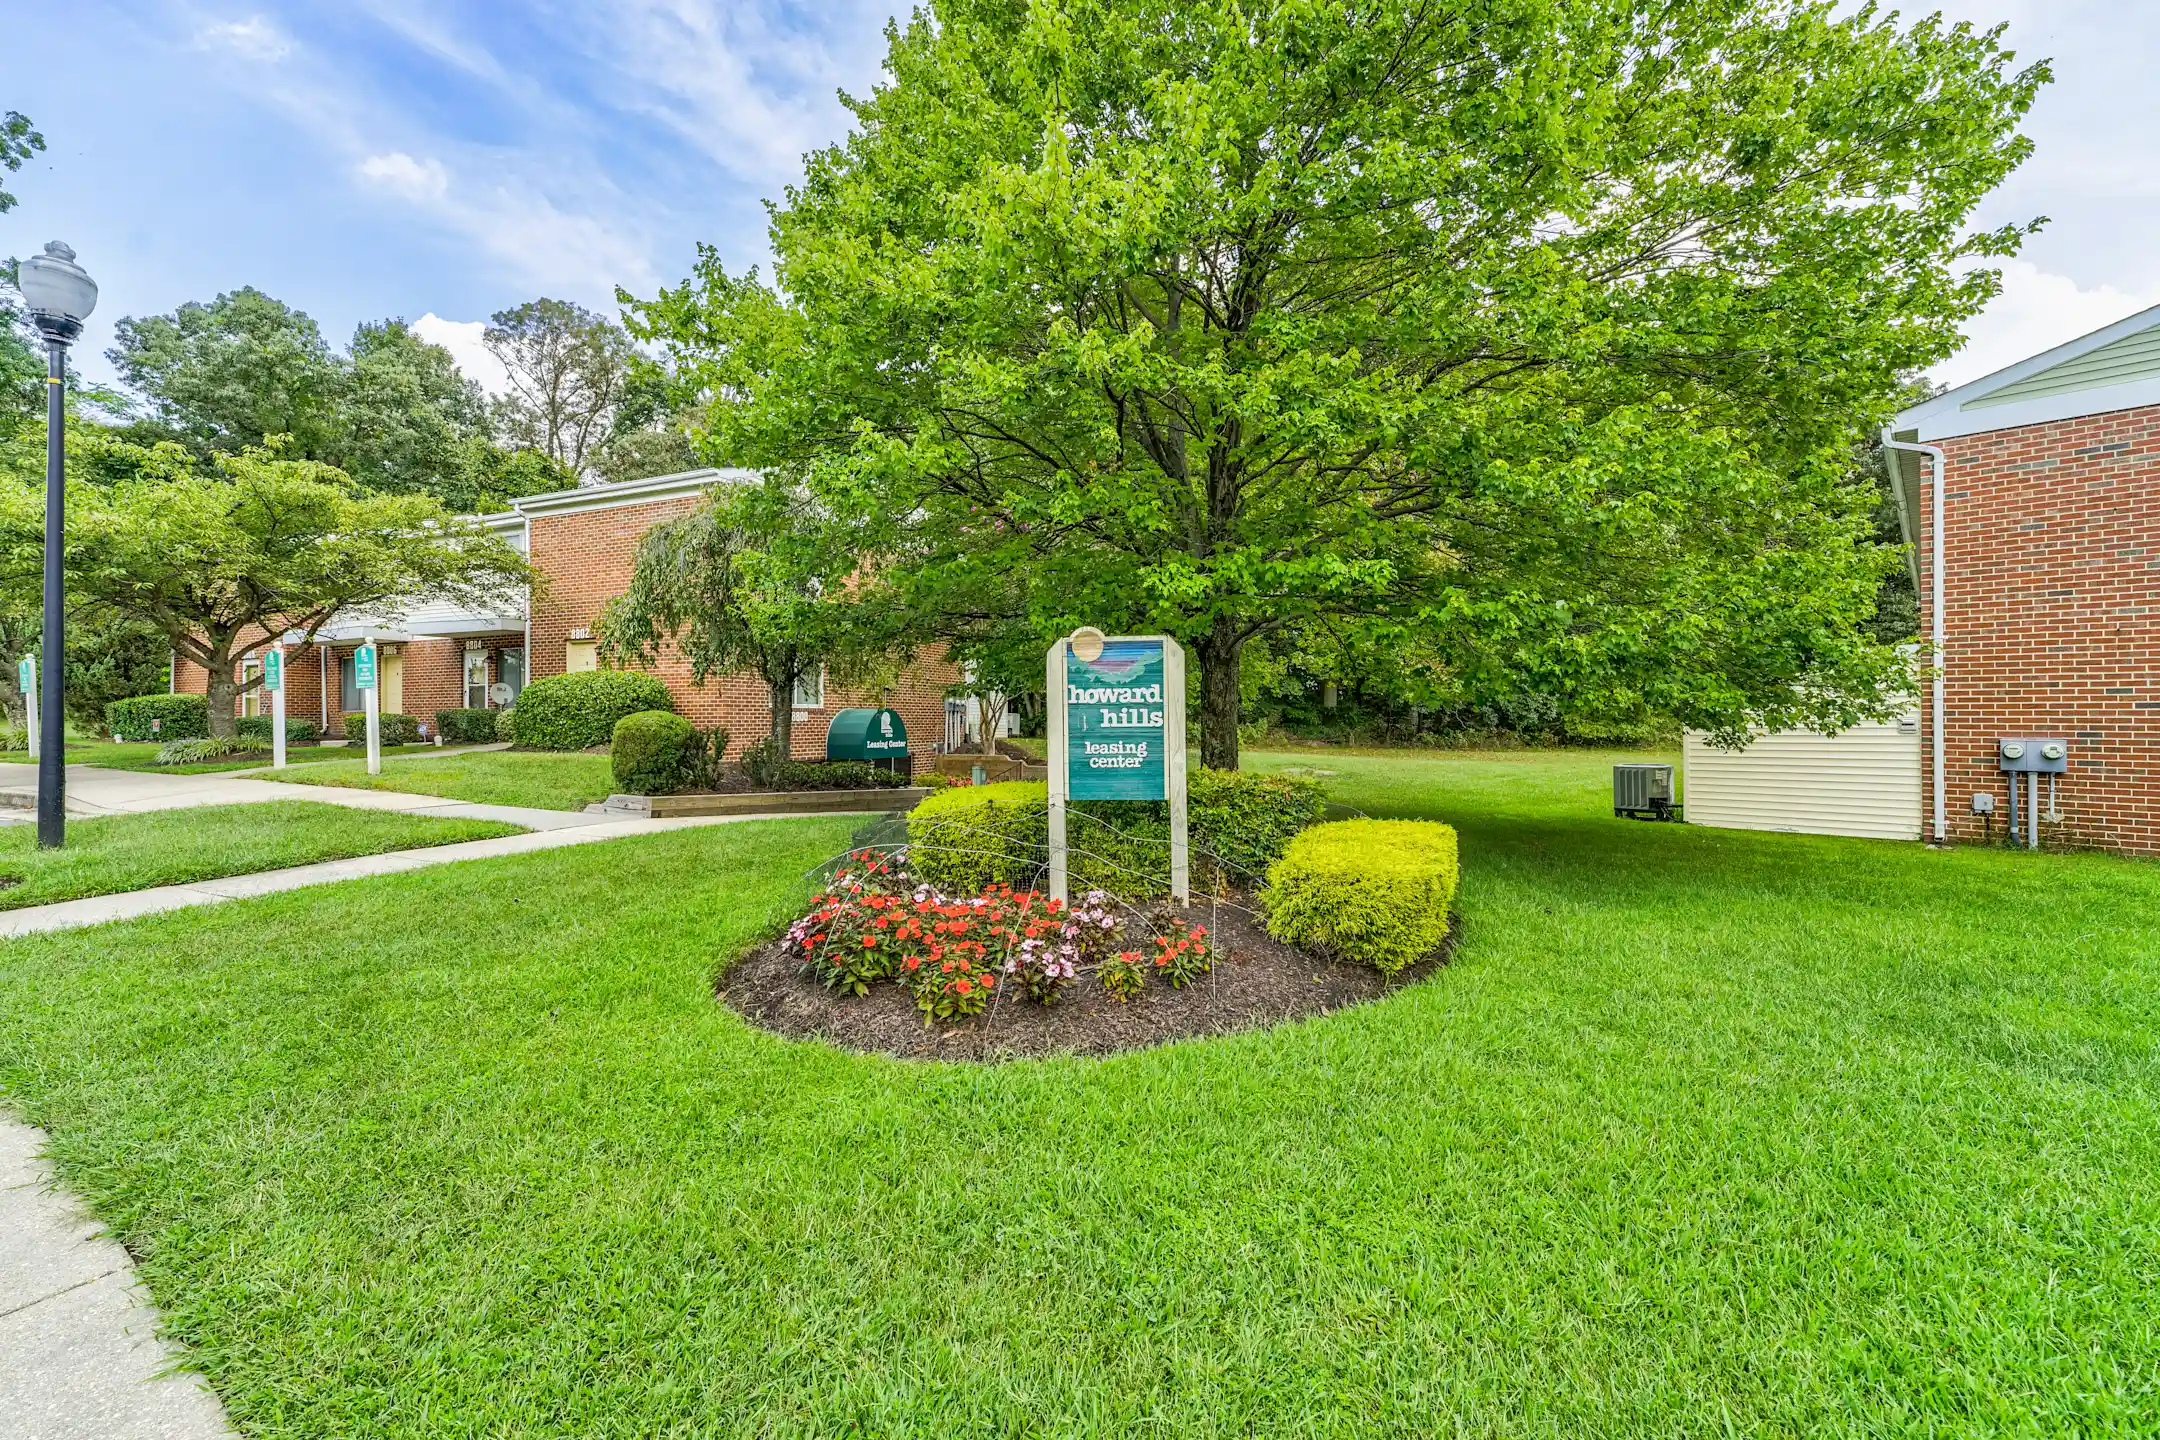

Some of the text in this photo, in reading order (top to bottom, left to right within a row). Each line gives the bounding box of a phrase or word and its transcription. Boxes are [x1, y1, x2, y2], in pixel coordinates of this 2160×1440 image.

[572, 628, 590, 639] 8802
[466, 640, 482, 650] 8804
[1068, 684, 1163, 703] howard
[1100, 708, 1163, 727] hills
[867, 741, 888, 749] Leasing
[1085, 741, 1147, 757] leasing
[1090, 755, 1143, 768] center
